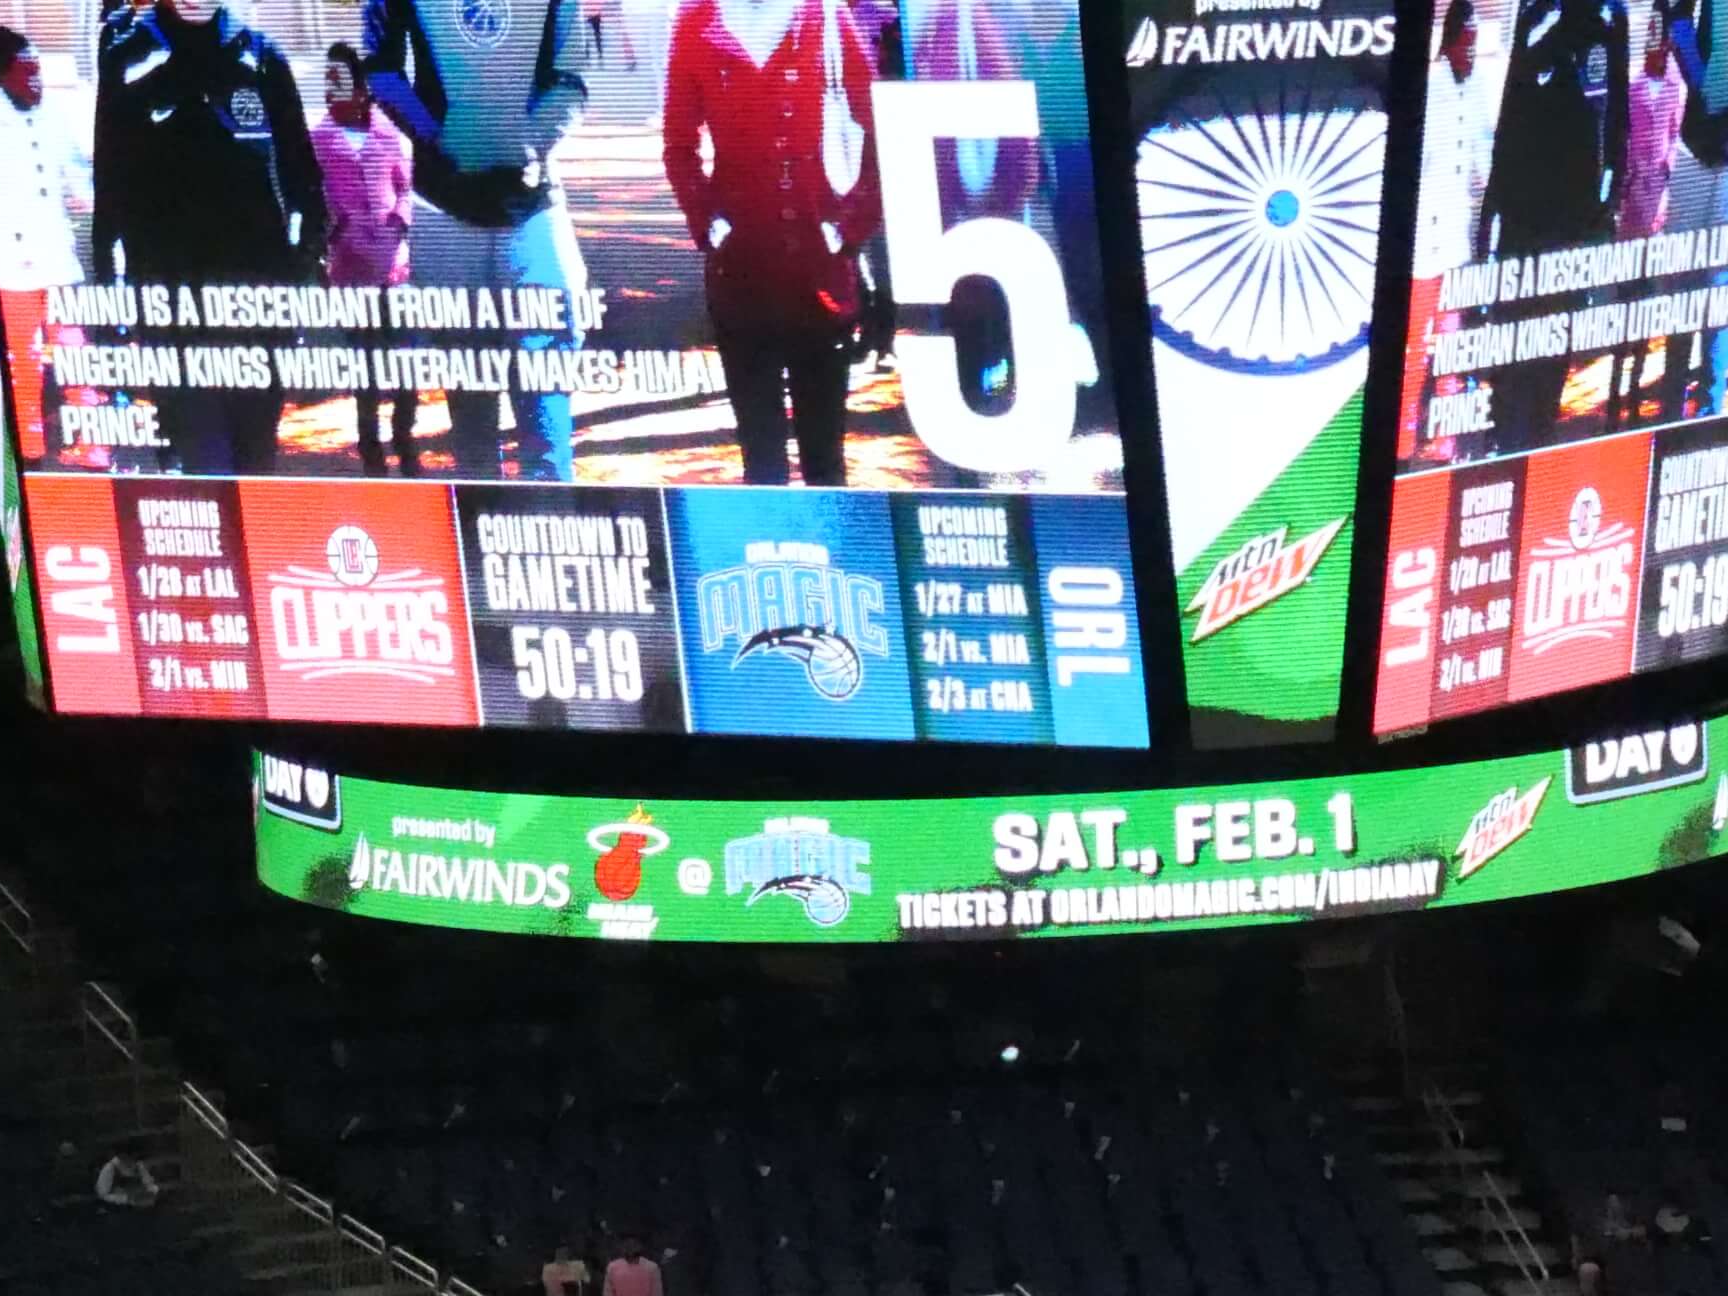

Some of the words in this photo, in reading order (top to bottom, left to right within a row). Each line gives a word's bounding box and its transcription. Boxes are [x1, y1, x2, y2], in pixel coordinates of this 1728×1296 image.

[1162, 15, 1397, 65] FAIRWINDS
[870, 80, 1078, 472] 5
[1439, 261, 1501, 312] AMINU
[1501, 266, 1518, 302] IS
[1519, 263, 1534, 299] A
[1538, 239, 1644, 297] DESCENDANT
[1645, 230, 1692, 276] FROM
[47, 286, 138, 328] AMINU
[143, 286, 172, 327] IS
[177, 286, 201, 327] A
[202, 286, 382, 329] DESCENDANT
[389, 287, 471, 329] FROM
[477, 288, 501, 330] A
[505, 288, 566, 330] LINE
[572, 288, 609, 331] OF
[1431, 317, 1515, 376] NIGERIAN
[1515, 308, 1569, 362] KINGS
[1571, 301, 1625, 352] WHICH
[1626, 286, 1708, 345] LITERALLY
[53, 345, 181, 387] NIGERIAN
[182, 347, 272, 389] KINGS
[275, 347, 370, 390] WHICH
[374, 348, 512, 393] LITERALLY
[517, 349, 619, 394] MAKES
[623, 350, 681, 394] HIM
[61, 404, 171, 447] PRINCE.
[138, 499, 221, 529] UPCOMING
[477, 513, 617, 556] COUNTDOWN
[617, 517, 649, 557] TO
[918, 506, 1008, 536] UPCOMING
[144, 528, 224, 557] SCHEDULE
[923, 536, 1009, 567] SCHEDULE
[45, 545, 120, 653] LAC
[203, 567, 240, 599] LAL
[482, 556, 655, 614] GAMETIME
[915, 580, 962, 619] 1/27
[986, 583, 1029, 617] MIA
[1385, 546, 1437, 668] LAC
[1524, 542, 1634, 638] CLIPPERS
[138, 611, 184, 646] 1/30
[211, 613, 250, 647] SAC
[268, 586, 454, 666] CLIPPERS
[697, 562, 890, 657] MAGIC
[1047, 566, 1132, 688] ORL
[511, 625, 644, 701] 50:19
[922, 627, 958, 668] 2/1
[989, 632, 1031, 665] MIA
[151, 656, 184, 691] 2/1
[210, 660, 249, 691] MIN
[926, 675, 966, 715] 2/3
[989, 680, 1035, 713] CHA
[264, 754, 303, 803] DAY
[1585, 731, 1666, 784] DAY
[391, 815, 469, 843] presented
[472, 816, 497, 849] by
[992, 810, 1158, 876] SAT.,
[1175, 798, 1315, 865] FEB.
[1327, 792, 1356, 852] 1
[372, 847, 571, 909] FAIRWINDS
[677, 857, 713, 896] @
[897, 890, 1009, 930] TICKETS
[1012, 889, 1046, 926] AT
[1051, 858, 1441, 924] ORLANDOMAGIC.COM/INDIADAY
